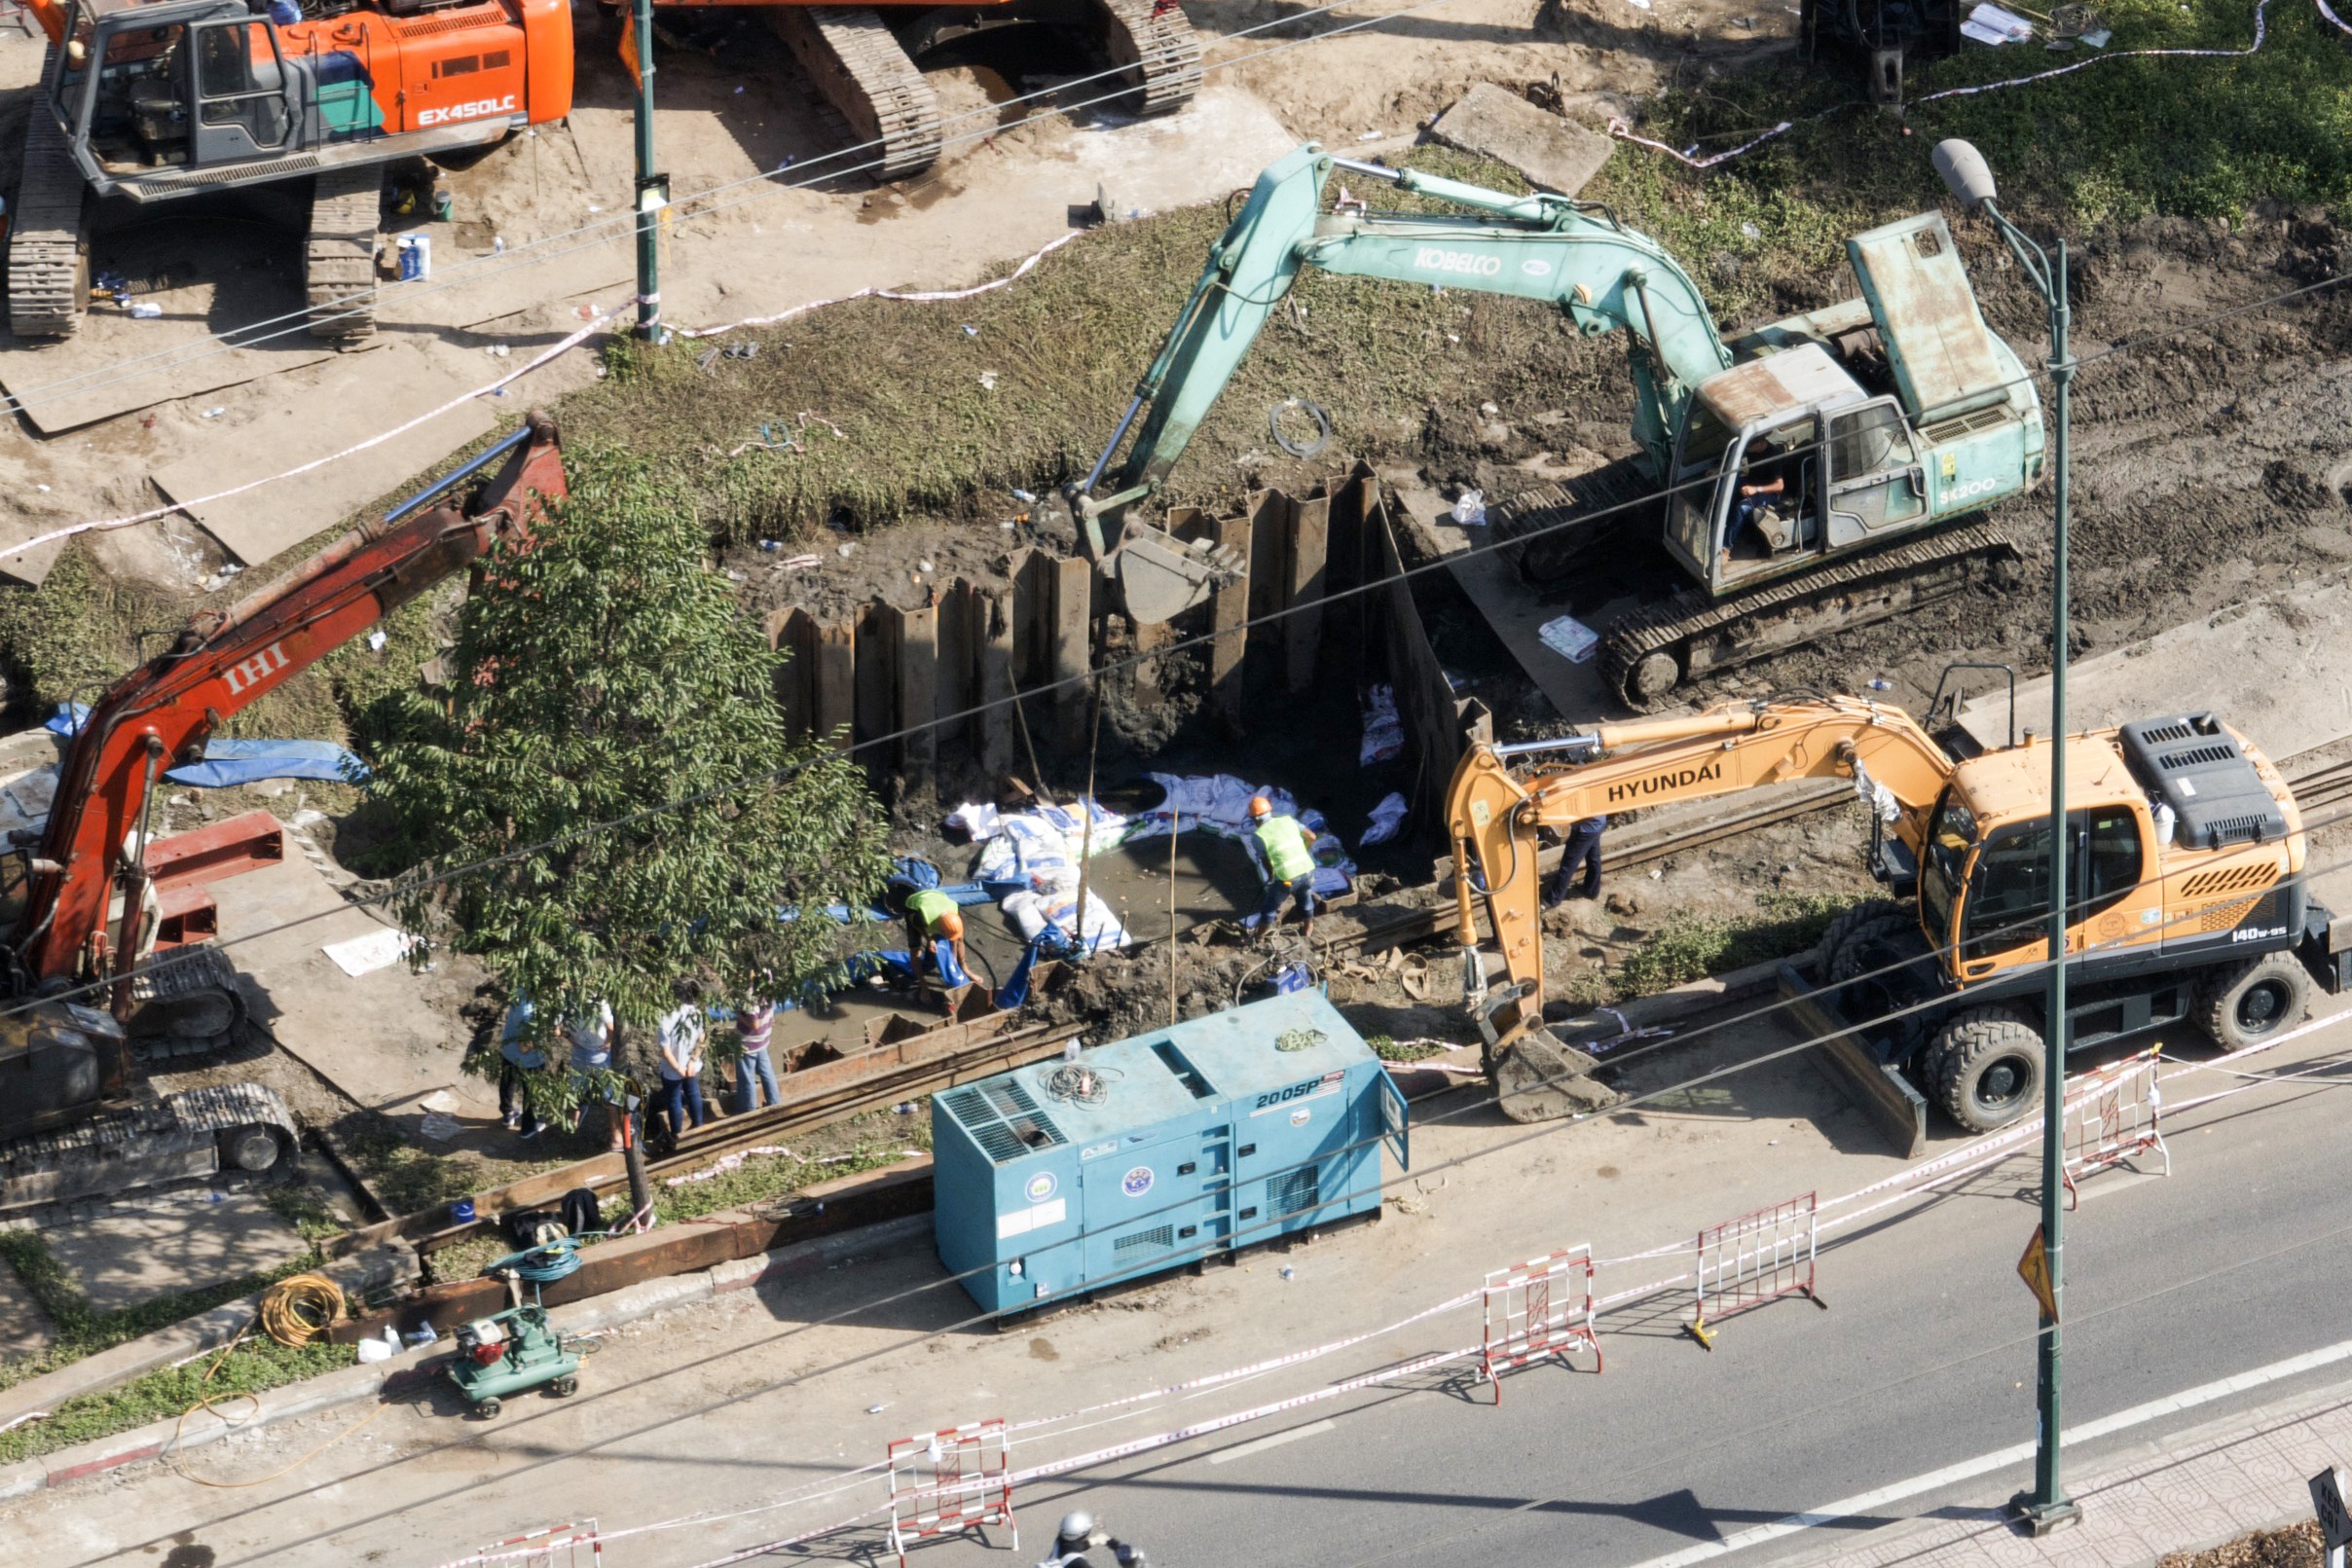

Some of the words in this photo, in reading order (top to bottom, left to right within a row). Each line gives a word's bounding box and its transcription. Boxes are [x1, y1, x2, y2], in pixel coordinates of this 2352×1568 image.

[418, 94, 515, 126] EX450LC
[1414, 247, 1501, 276] KOBELCO
[1940, 477, 1996, 505] SK200
[222, 641, 291, 696] IHI
[1608, 763, 1721, 802] HYUNDAI
[1256, 1078, 1320, 1109] 200SP
